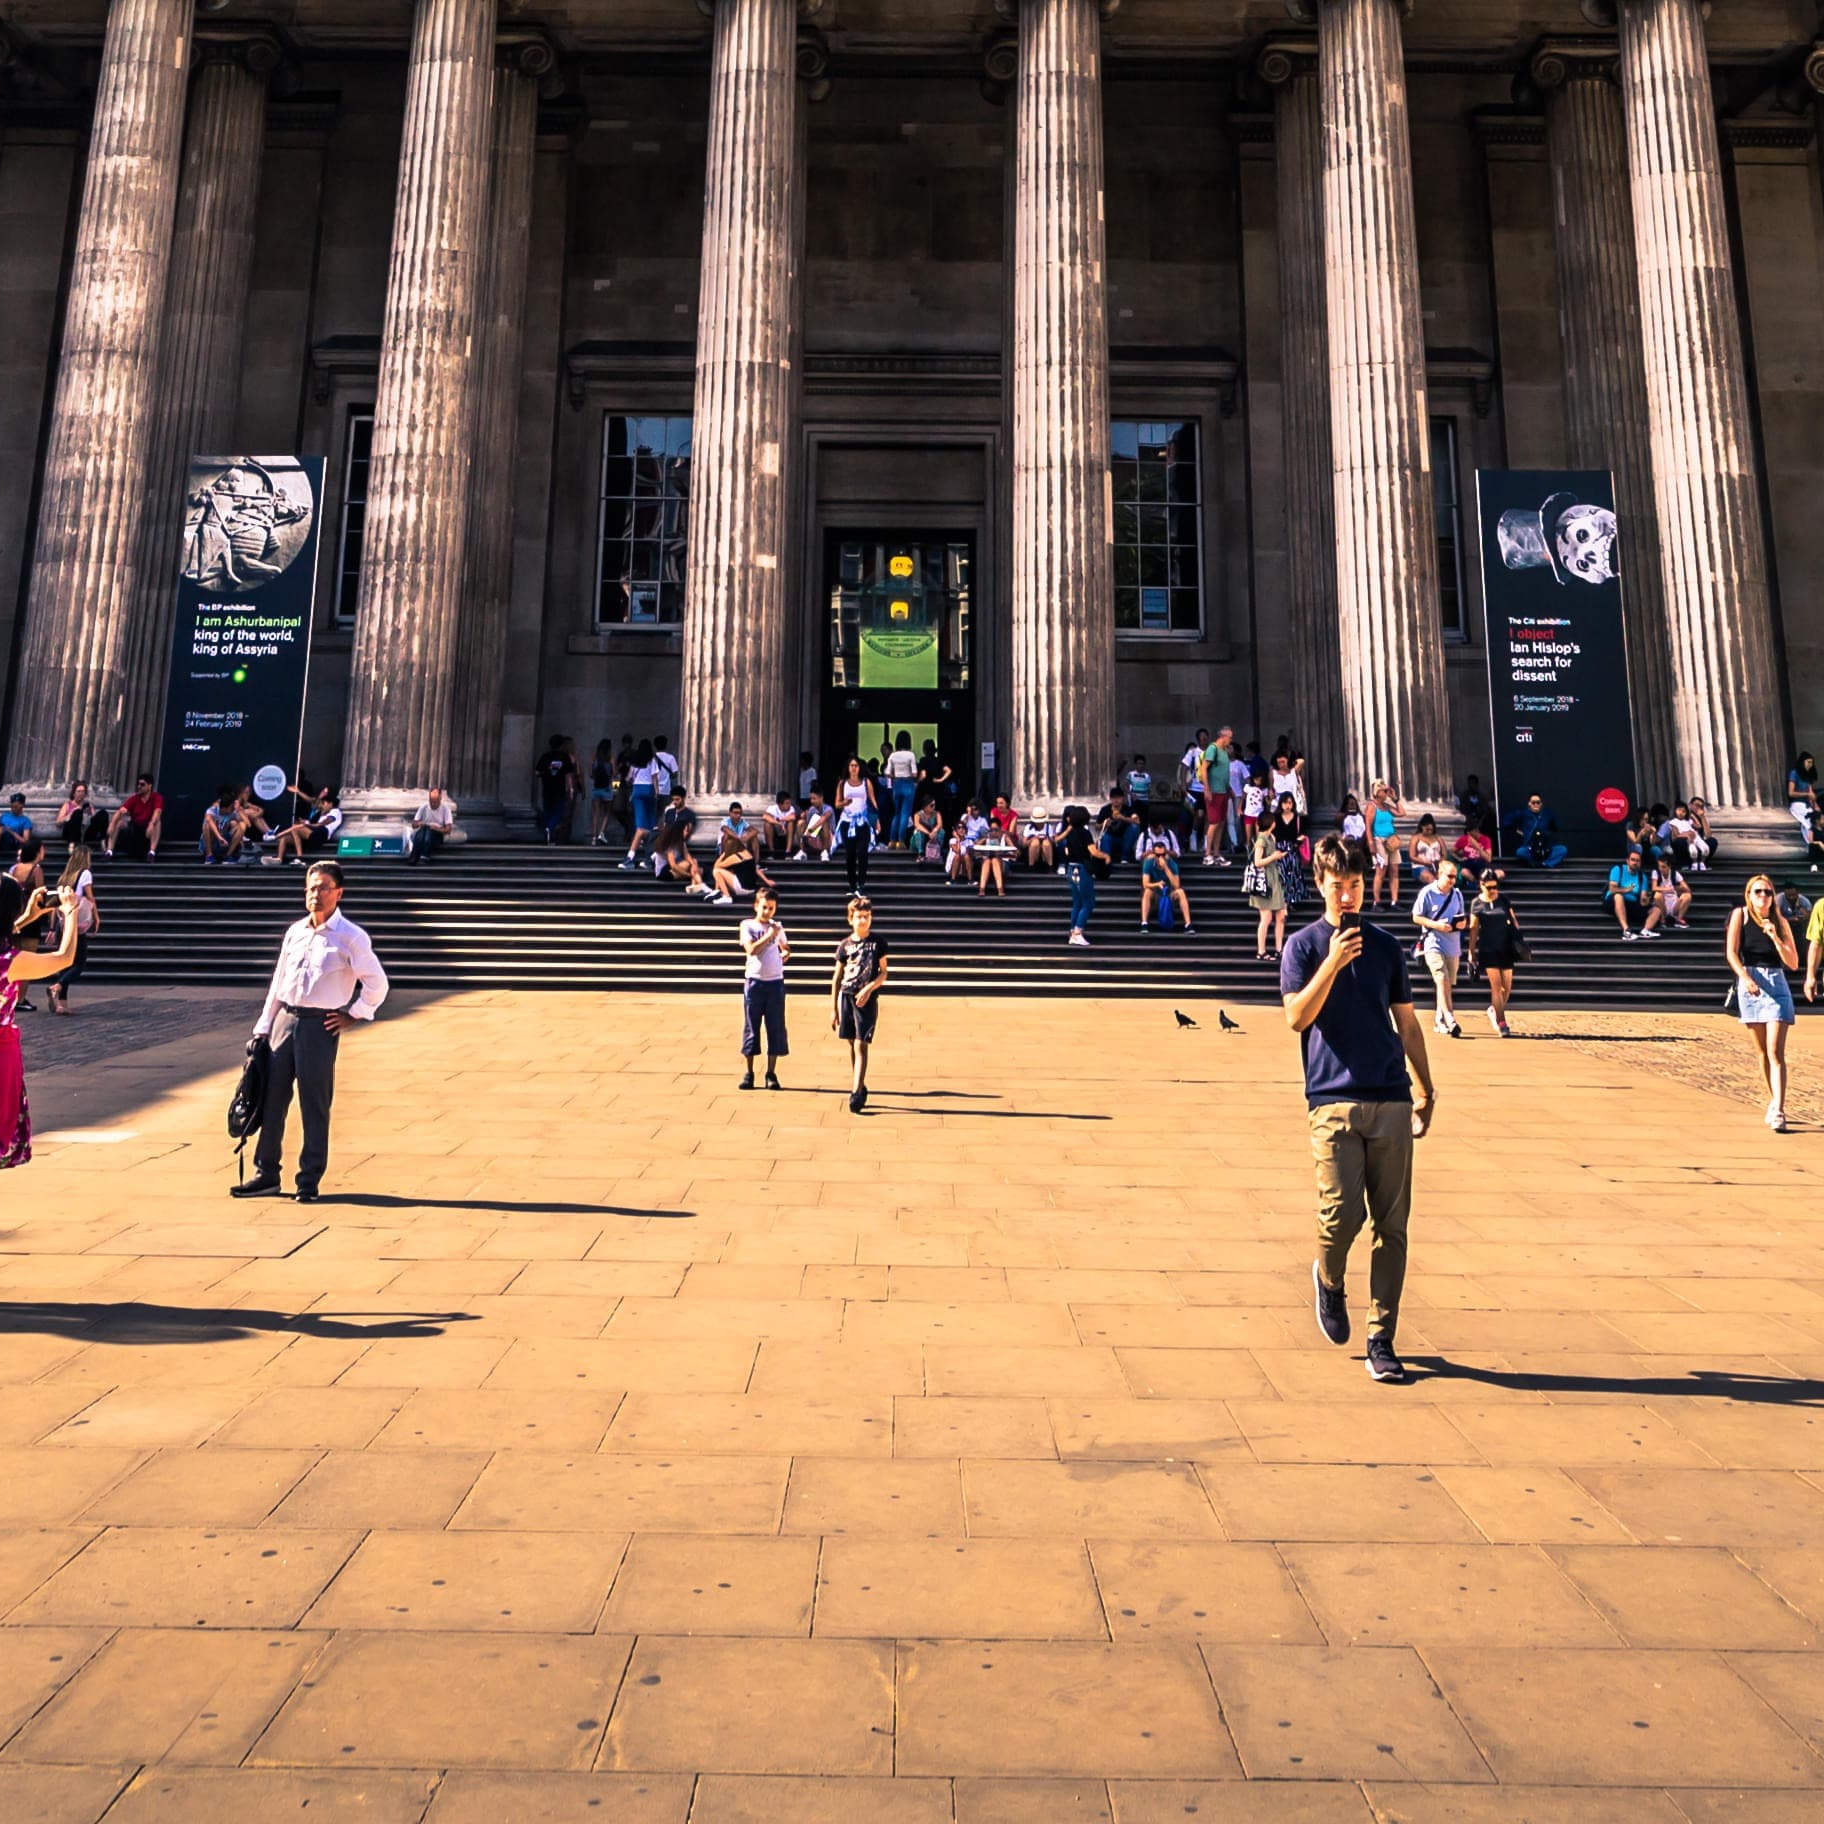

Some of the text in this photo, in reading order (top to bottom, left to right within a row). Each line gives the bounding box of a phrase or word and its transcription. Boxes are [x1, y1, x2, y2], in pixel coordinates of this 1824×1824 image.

[196, 615, 301, 628] I am Ashurbanipal
[1508, 617, 1522, 625] The
[194, 629, 294, 642] king of the world,
[1509, 628, 1554, 640] I object
[192, 643, 278, 656] king of Assyria
[1510, 641, 1581, 655] Ian Hislop's
[1511, 656, 1572, 667] search for
[1512, 669, 1557, 682] dissent
[195, 720, 224, 730] February
